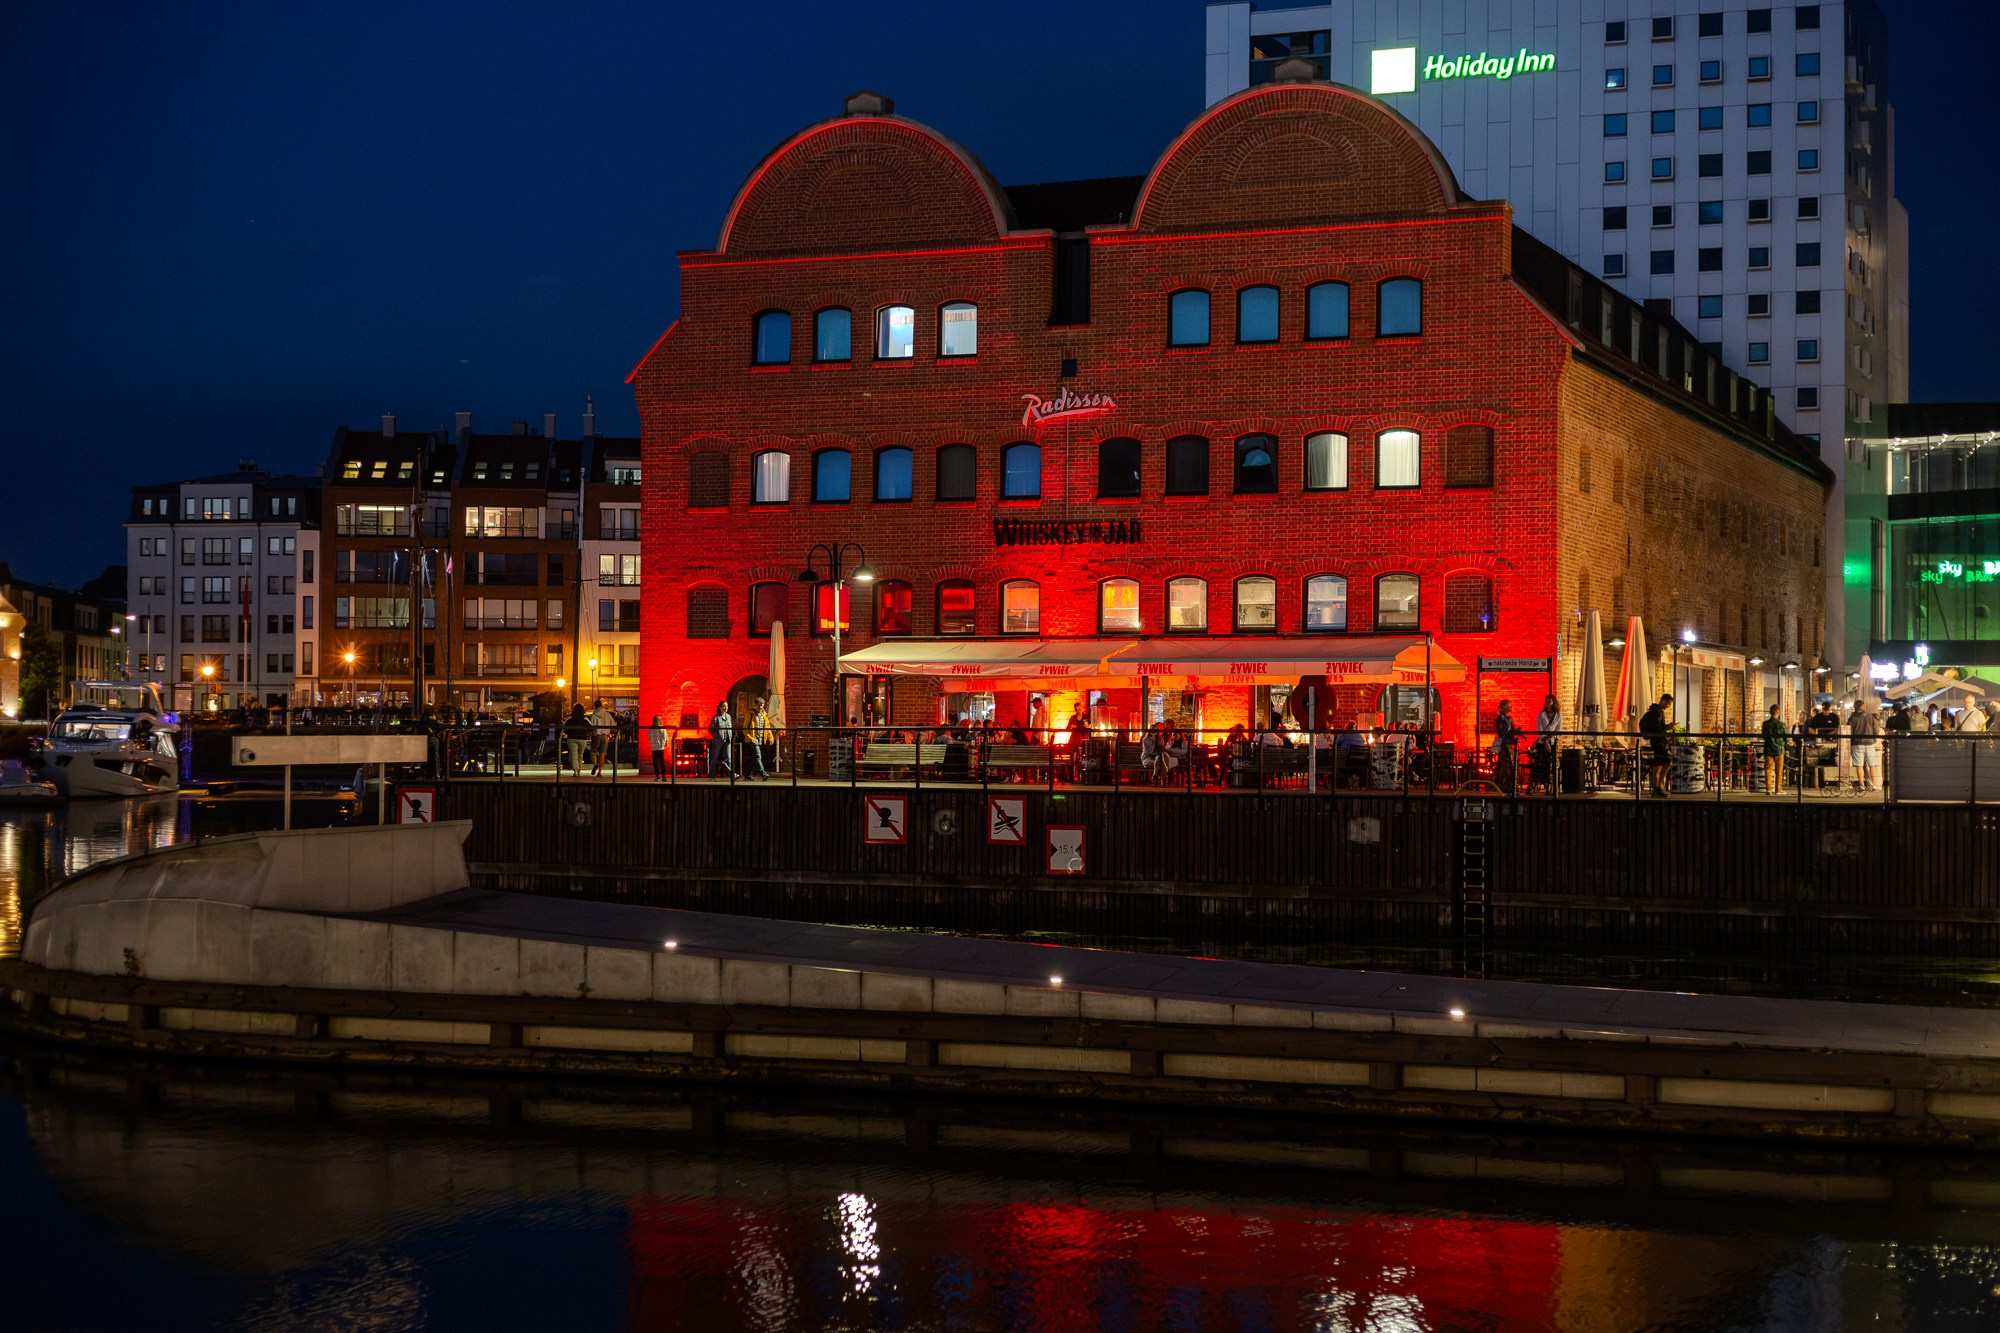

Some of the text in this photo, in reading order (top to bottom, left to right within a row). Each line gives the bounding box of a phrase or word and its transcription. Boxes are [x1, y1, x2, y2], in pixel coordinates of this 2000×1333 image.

[1423, 48, 1555, 80] Holiday Inn
[1021, 386, 1116, 426] Radisson
[993, 519, 1086, 547] WHISKEY
[1102, 521, 1141, 544] JAR
[1938, 560, 1962, 578] sky
[1137, 662, 1173, 675] ŻYWIEC
[1230, 662, 1268, 674] ŻYWIEC
[1325, 661, 1364, 674] ŻYWIEC
[1059, 845, 1074, 855] 15,1
